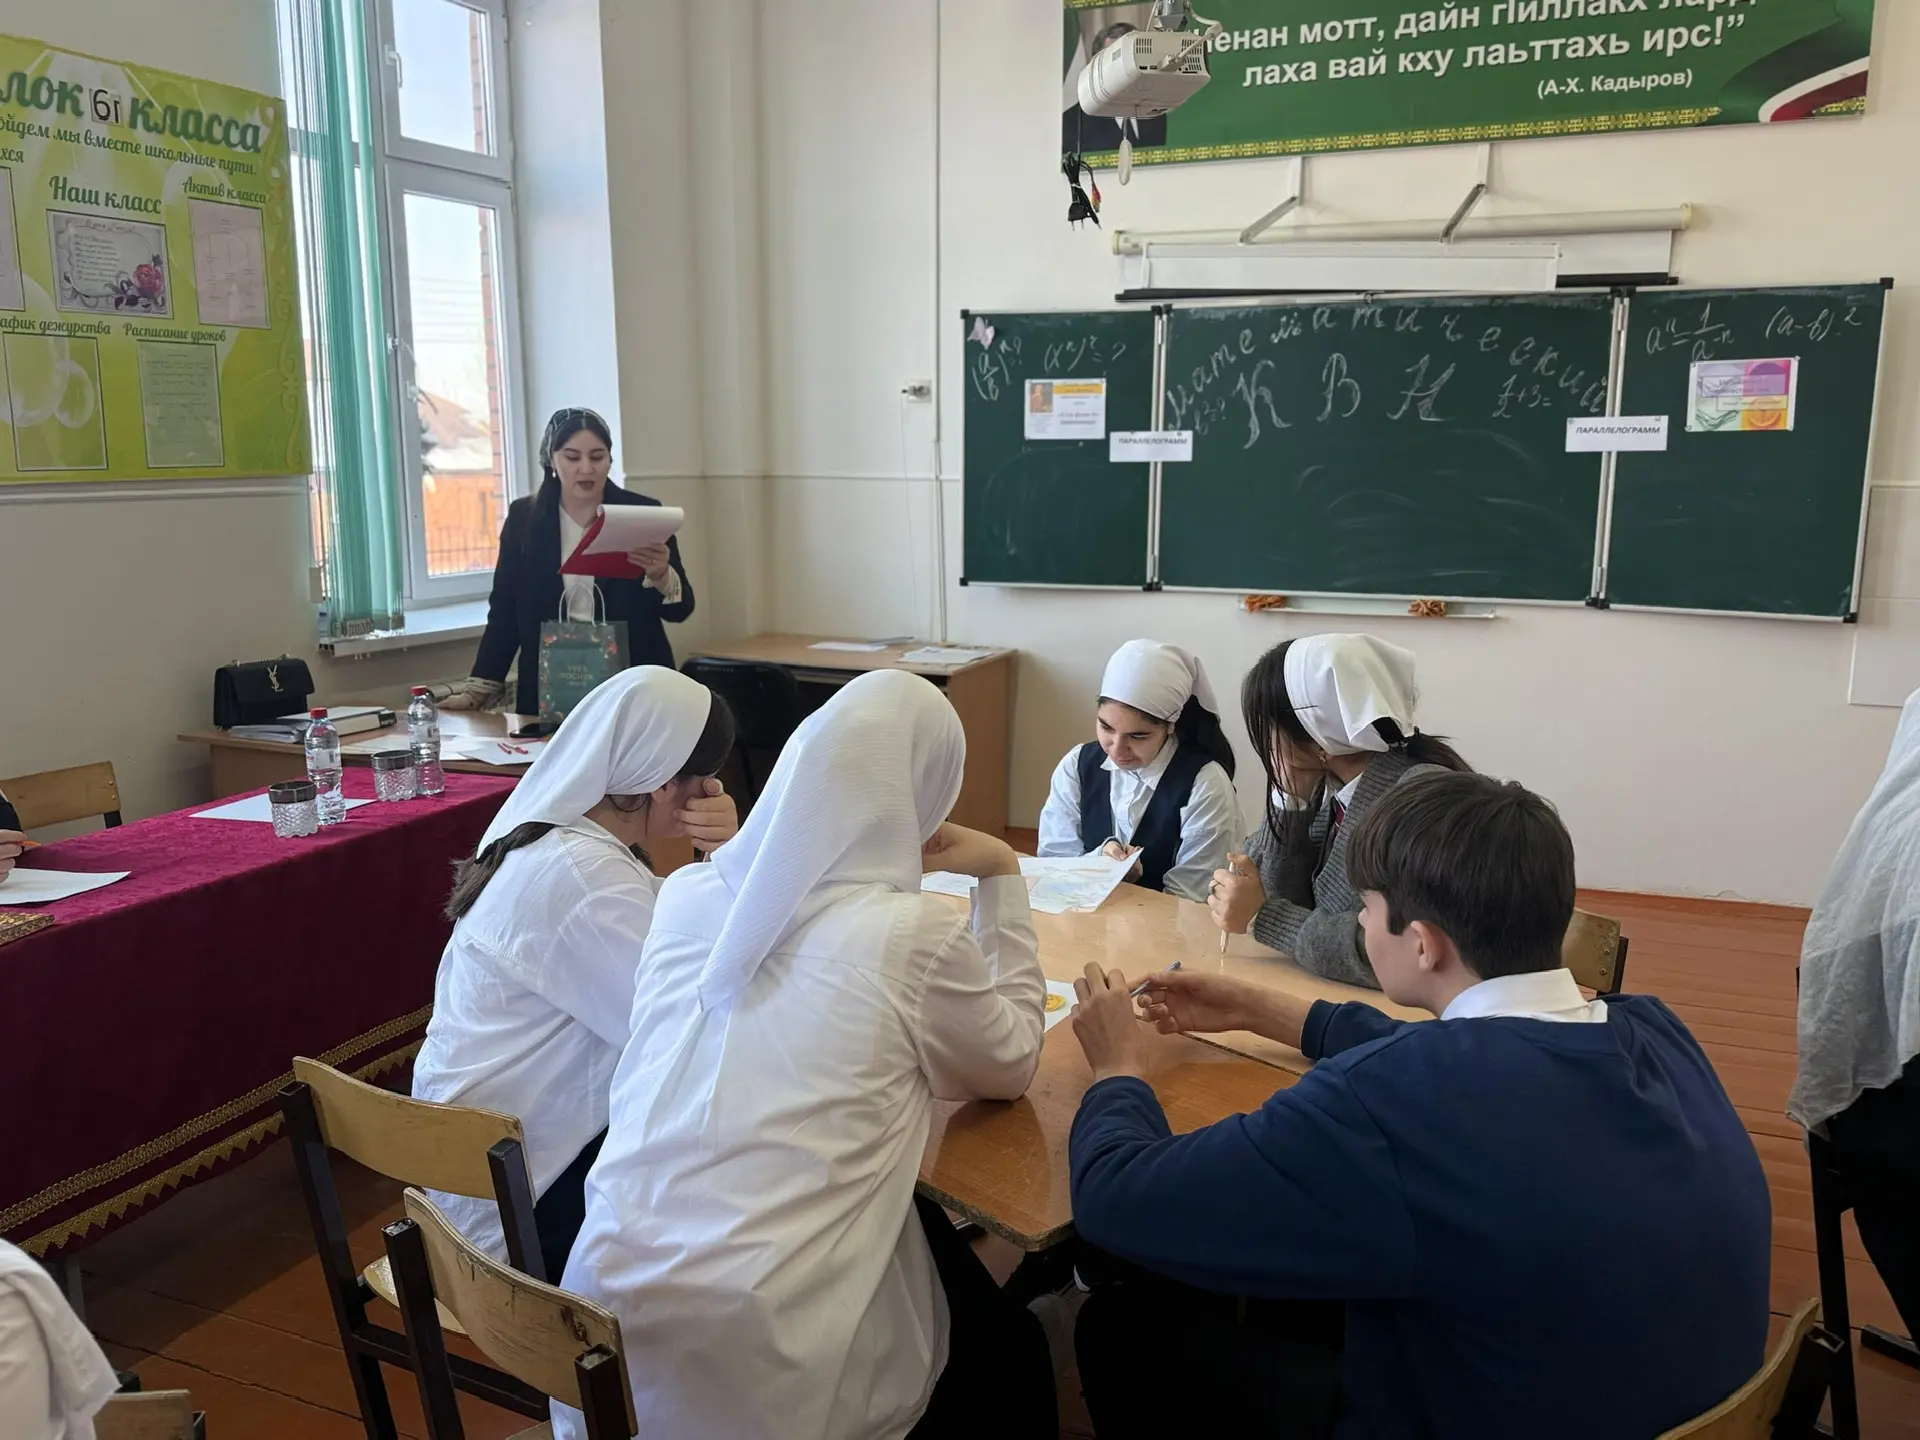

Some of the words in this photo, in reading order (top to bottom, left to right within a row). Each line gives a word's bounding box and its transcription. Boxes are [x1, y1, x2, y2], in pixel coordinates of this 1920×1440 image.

[1300, 16, 1385, 45] мотт,
[1395, 2, 1480, 40] дайн
[1243, 61, 1317, 87] лаха
[1328, 48, 1387, 79] вай
[1398, 47, 1454, 77] кху
[1462, 33, 1630, 68] лаьттахь
[1591, 68, 1693, 93] Кадыров)
[0, 71, 84, 118] лок
[129, 97, 261, 153] класса
[53, 128, 81, 143] мы
[84, 129, 141, 154] вместе
[145, 145, 216, 168] школьные
[219, 157, 257, 176] пути.
[49, 175, 99, 204] Наш
[104, 190, 162, 214] класс
[182, 176, 224, 197] Актив
[226, 187, 267, 204] класса
[39, 319, 111, 336] дежурства
[123, 323, 188, 341] Расписание
[190, 329, 226, 344] уроков
[1118, 437, 1188, 445] ПАРАЛЛЕЛОГРАММ
[1576, 426, 1660, 435] ПАРАЛЛЕЛОГРАММ
